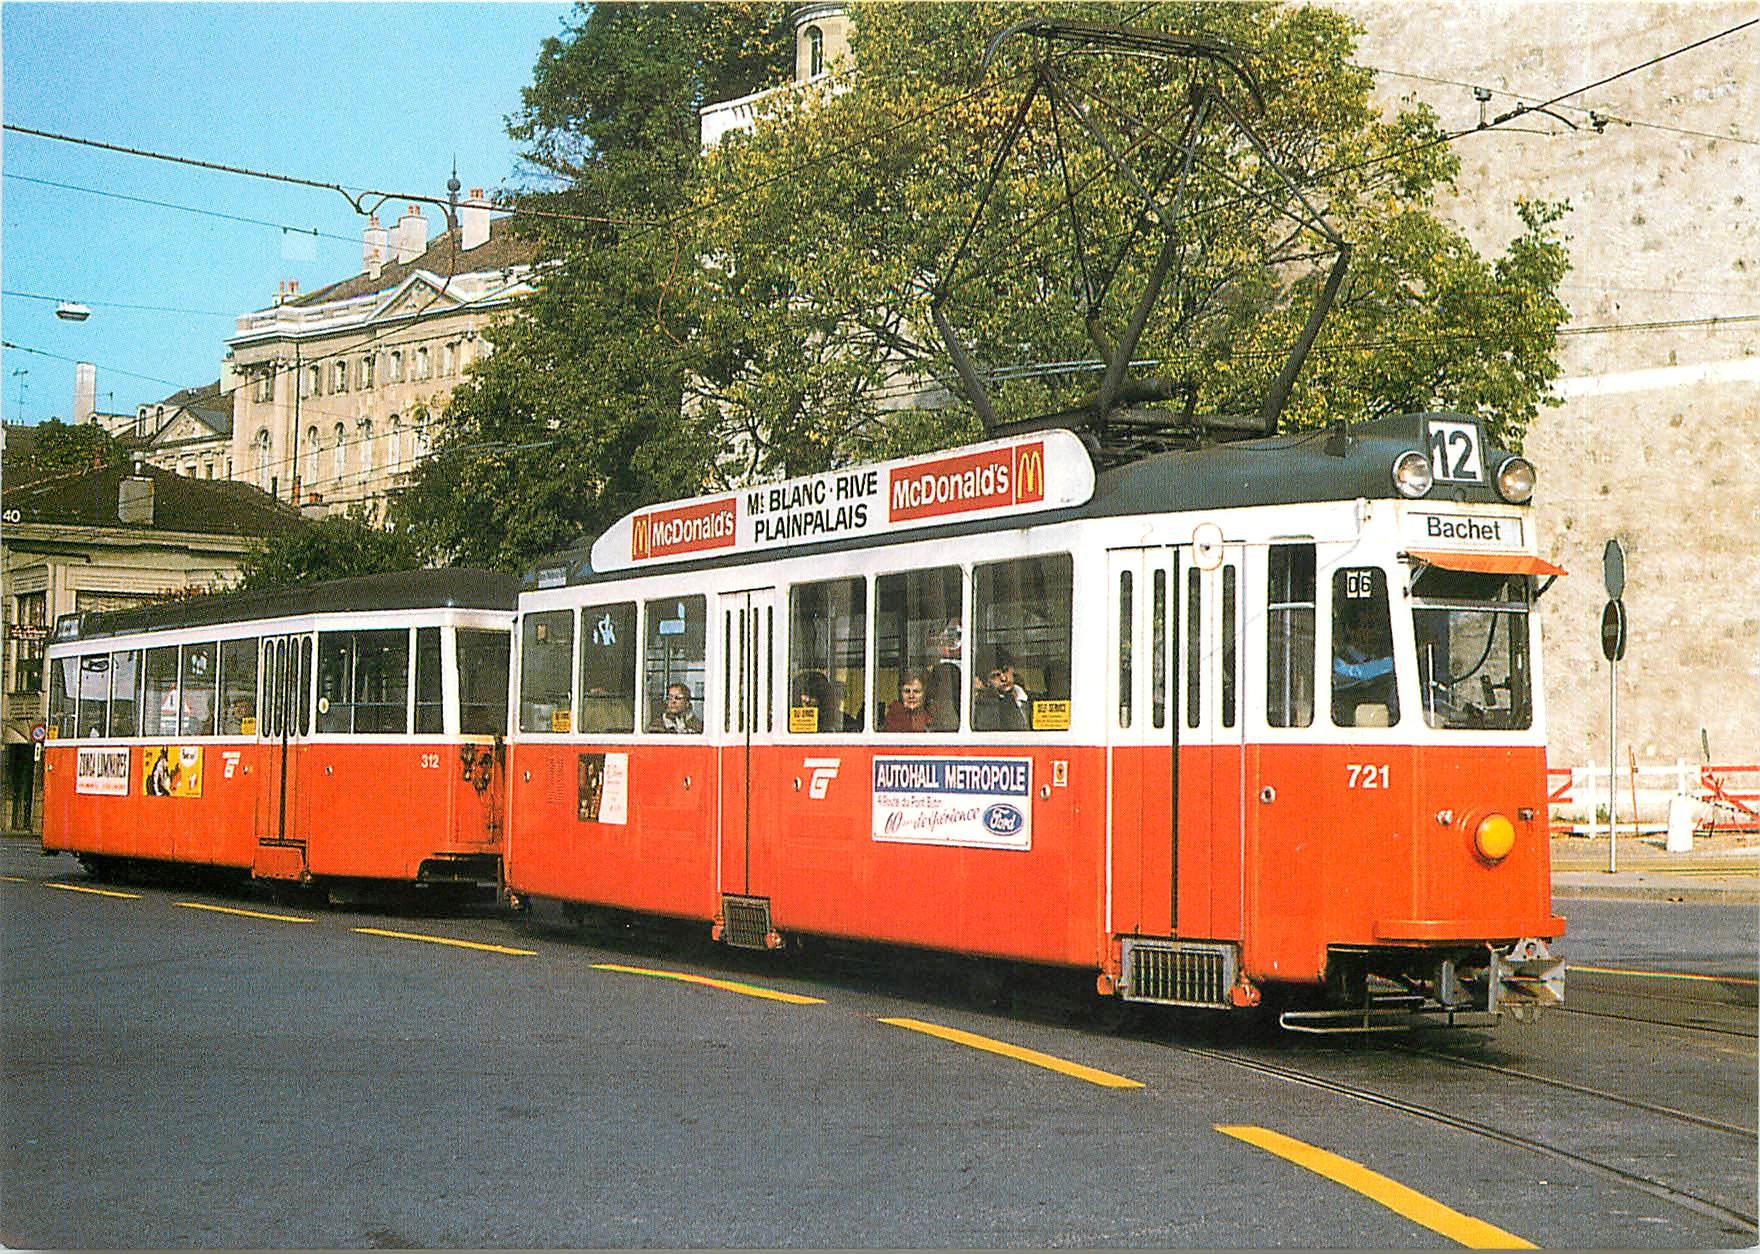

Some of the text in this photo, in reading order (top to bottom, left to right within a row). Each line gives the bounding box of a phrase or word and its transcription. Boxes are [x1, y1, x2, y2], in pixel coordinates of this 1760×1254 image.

[1431, 429, 1478, 480] 12
[770, 482, 826, 514] BLANC
[836, 470, 878, 497] RIVE
[892, 462, 1010, 512] McDonald's
[3, 509, 21, 523] 40
[652, 508, 735, 548] McDonald's
[754, 504, 868, 543] PLAINPALAIS
[1427, 516, 1502, 541] Bachet
[421, 754, 440, 769] 312
[876, 764, 1026, 791] AUTOHALL METROPOLE
[1345, 763, 1390, 789] 721
[990, 808, 1018, 831] Ford
